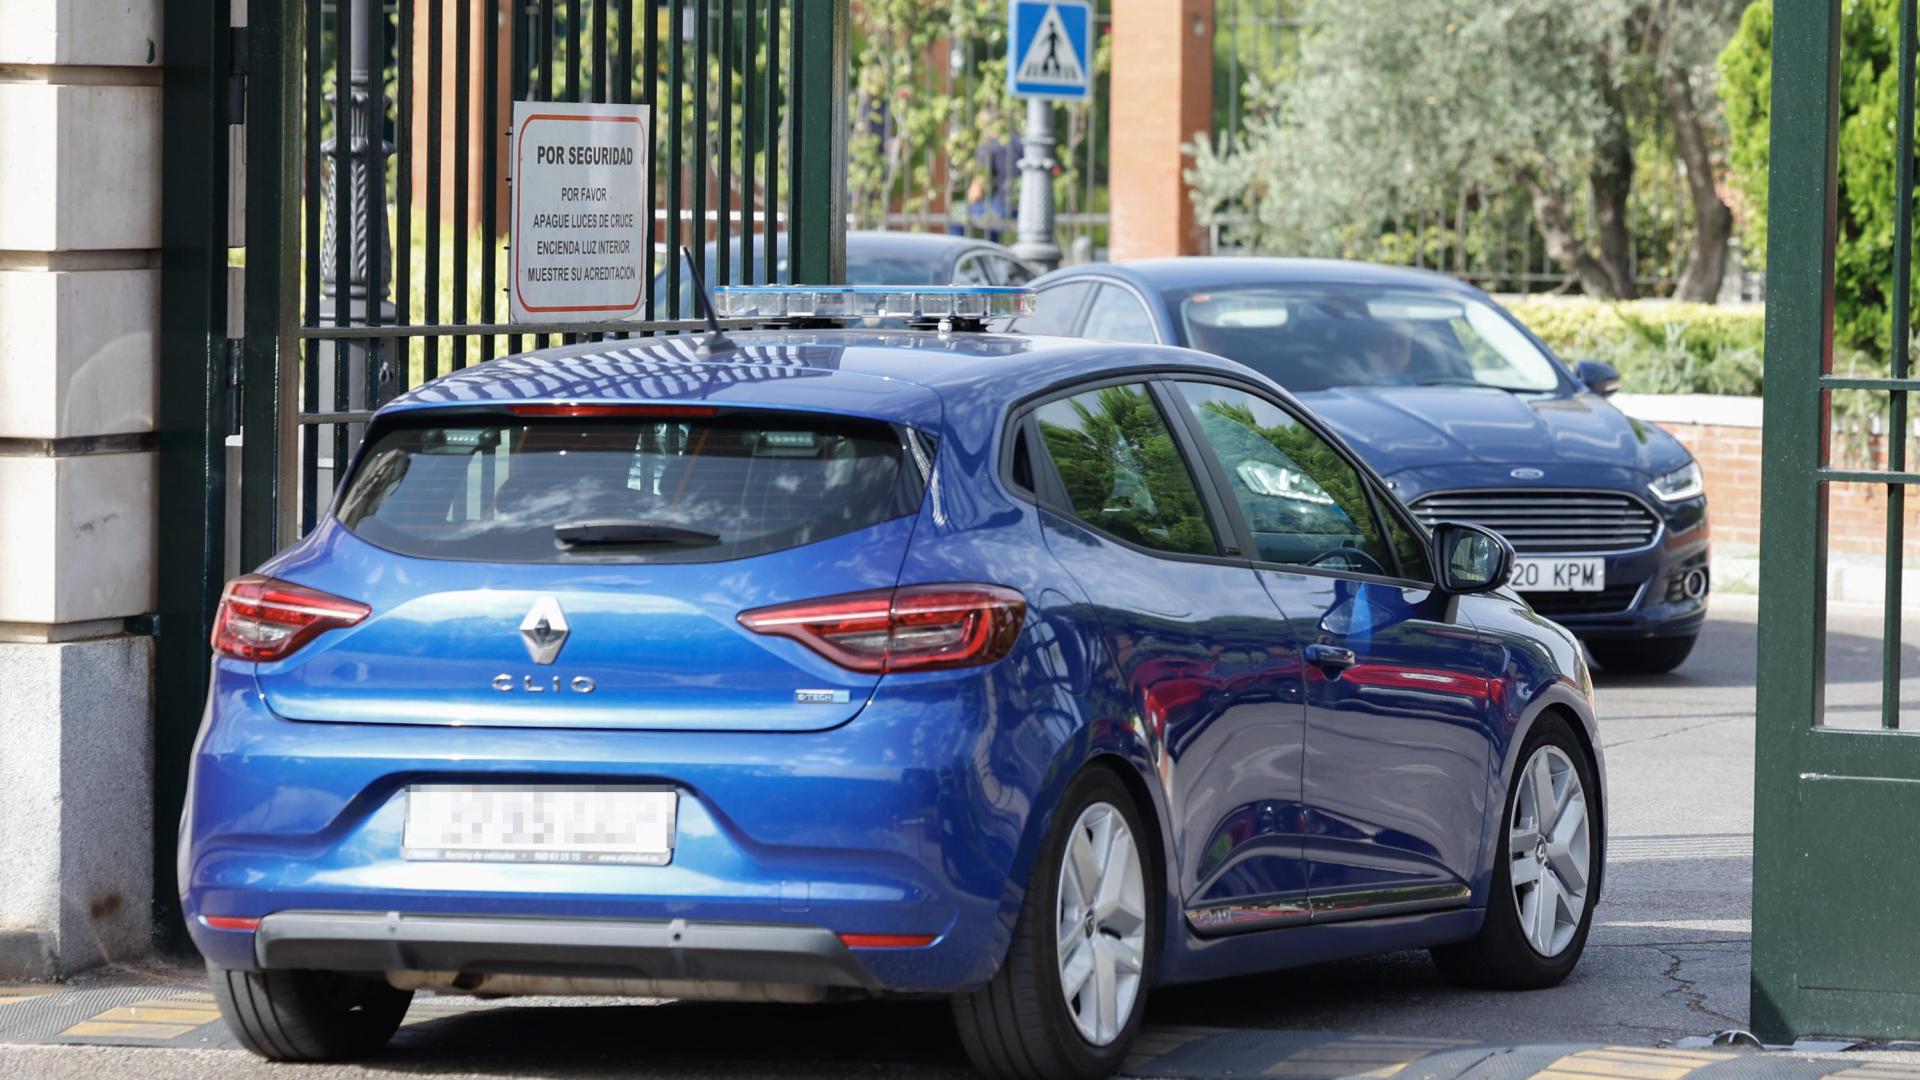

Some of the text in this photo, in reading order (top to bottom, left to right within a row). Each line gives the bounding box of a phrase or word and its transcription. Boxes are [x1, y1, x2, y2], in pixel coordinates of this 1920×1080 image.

[537, 145, 633, 166] POR SEGURIDAD
[561, 187, 607, 202] POR FAVOR
[532, 213, 633, 229] APAGUE LUCES DE CRUCE
[536, 239, 630, 255] ENCIENDA LUZ INTERIOR
[527, 263, 636, 282] MUESTRE SU ACREDITACIÓN
[1553, 563, 1596, 586] KPM
[491, 673, 597, 693] CLIO
